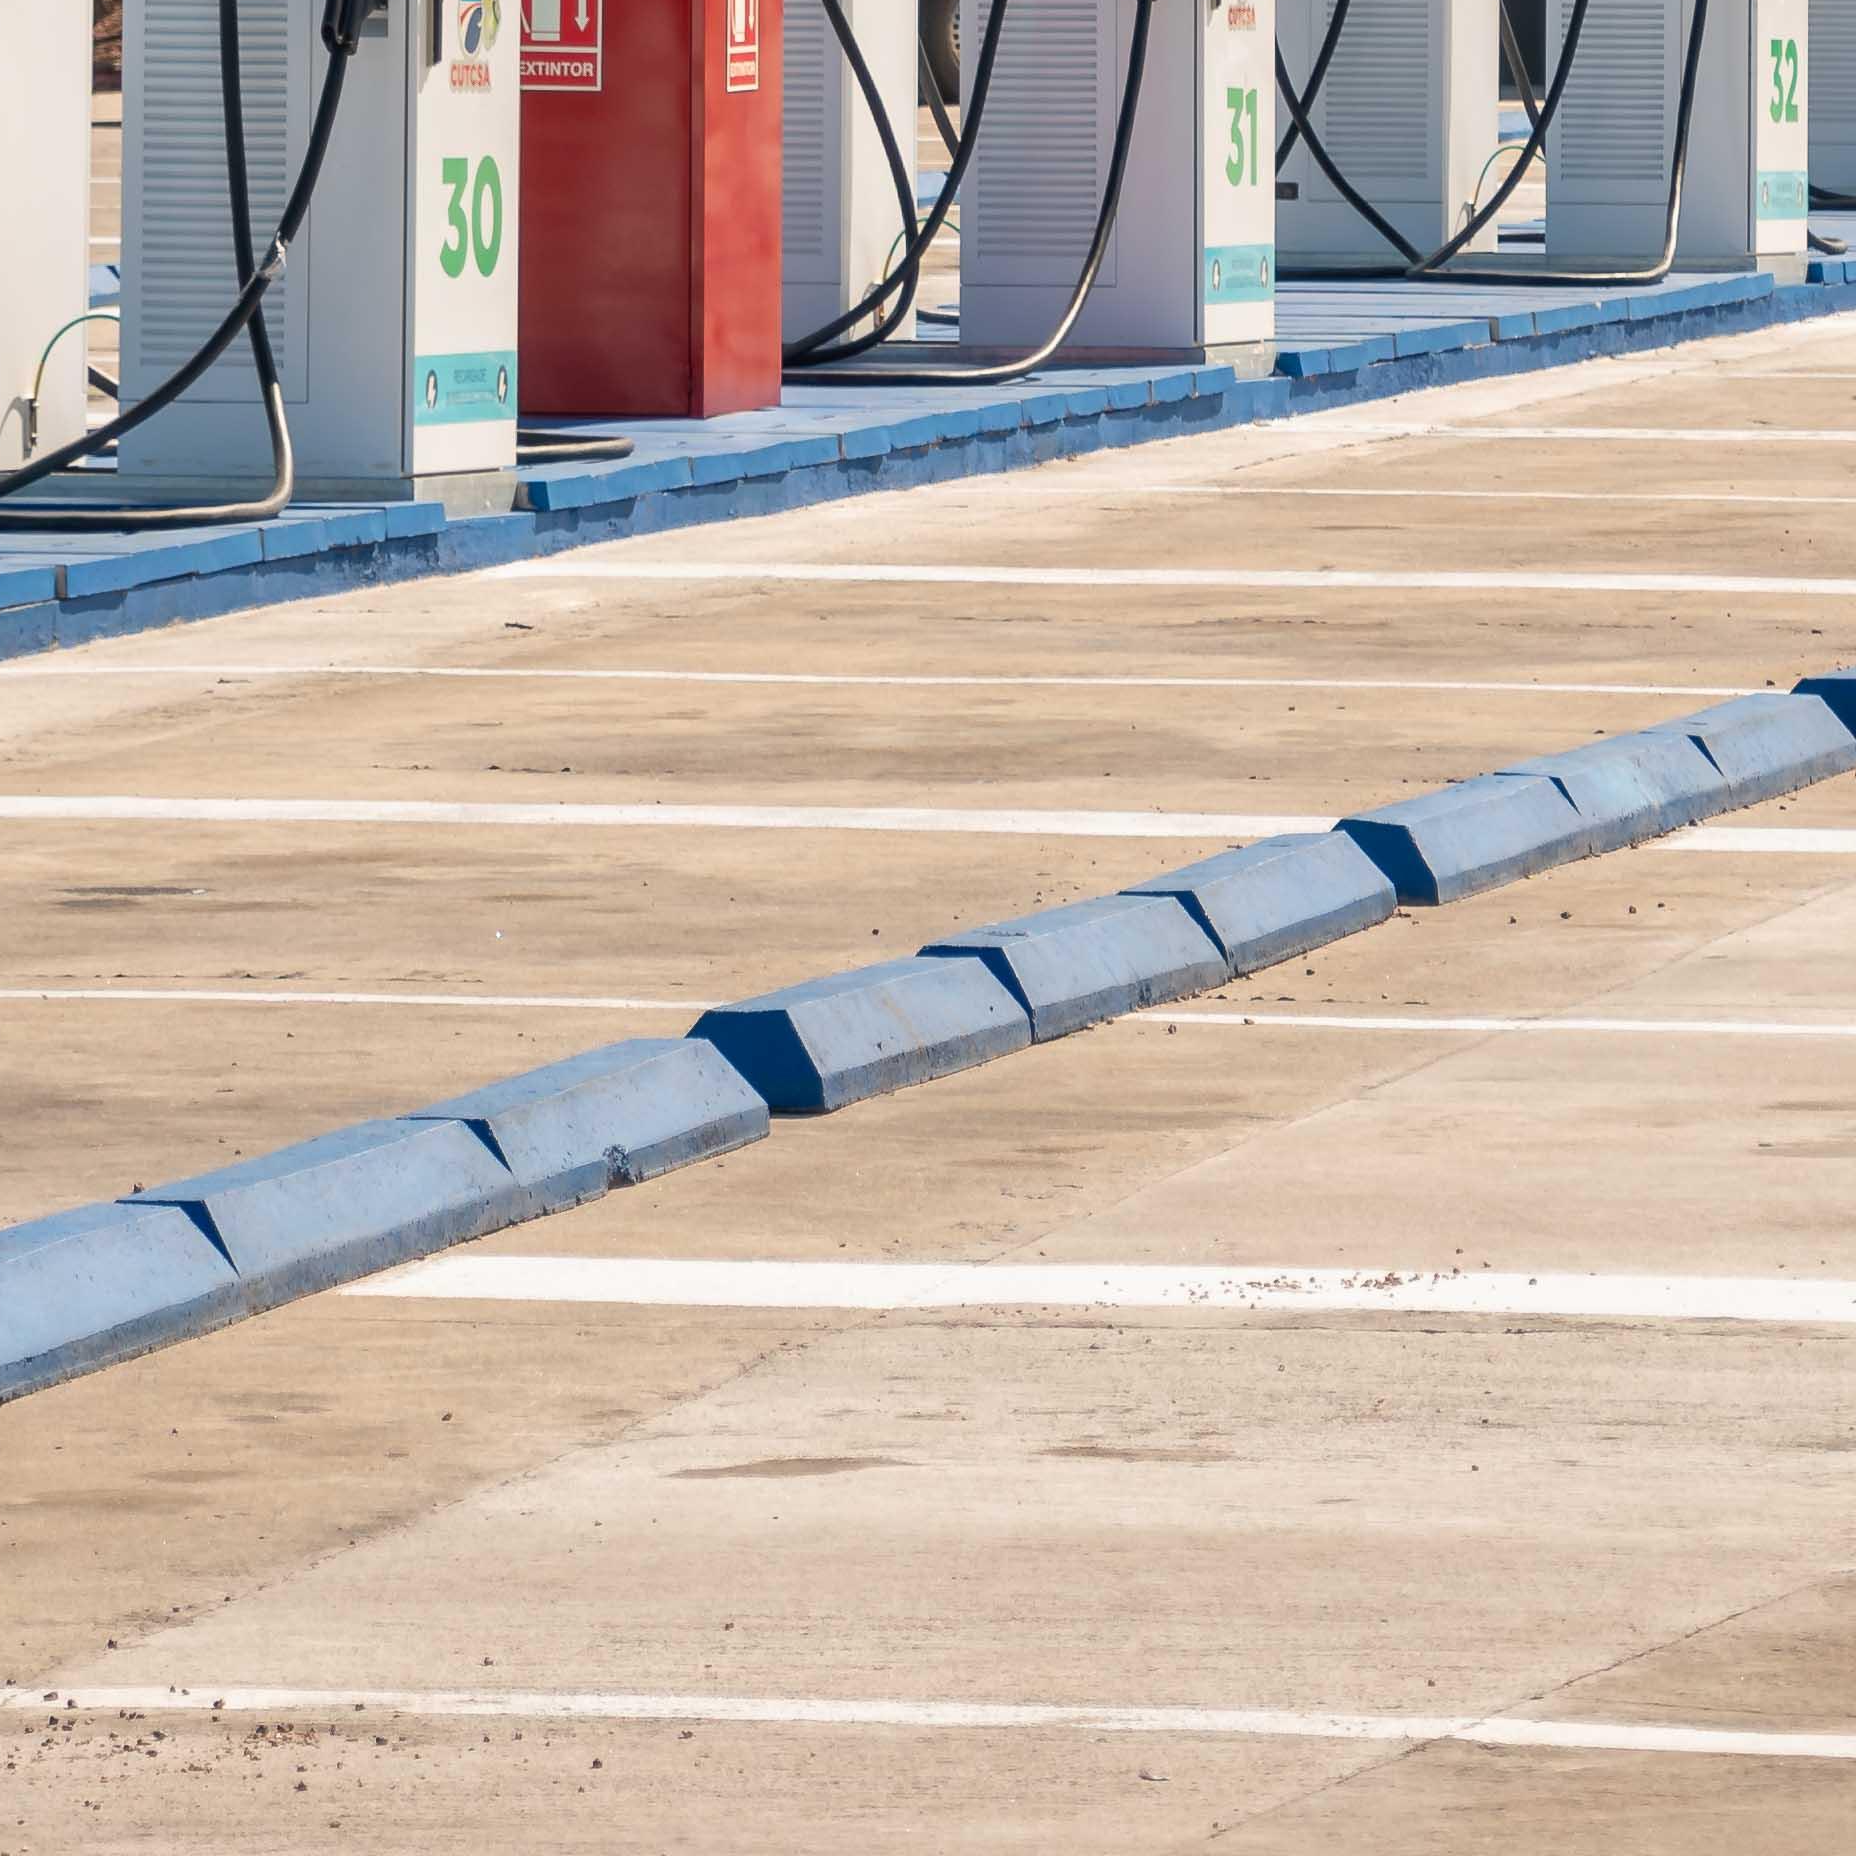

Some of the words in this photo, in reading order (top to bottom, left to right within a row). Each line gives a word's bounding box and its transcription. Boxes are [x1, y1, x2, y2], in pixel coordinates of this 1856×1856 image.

[450, 63, 490, 88] CUTCSA
[1769, 38, 1799, 123] 32
[1226, 87, 1258, 186] 31
[440, 155, 502, 278] 30
